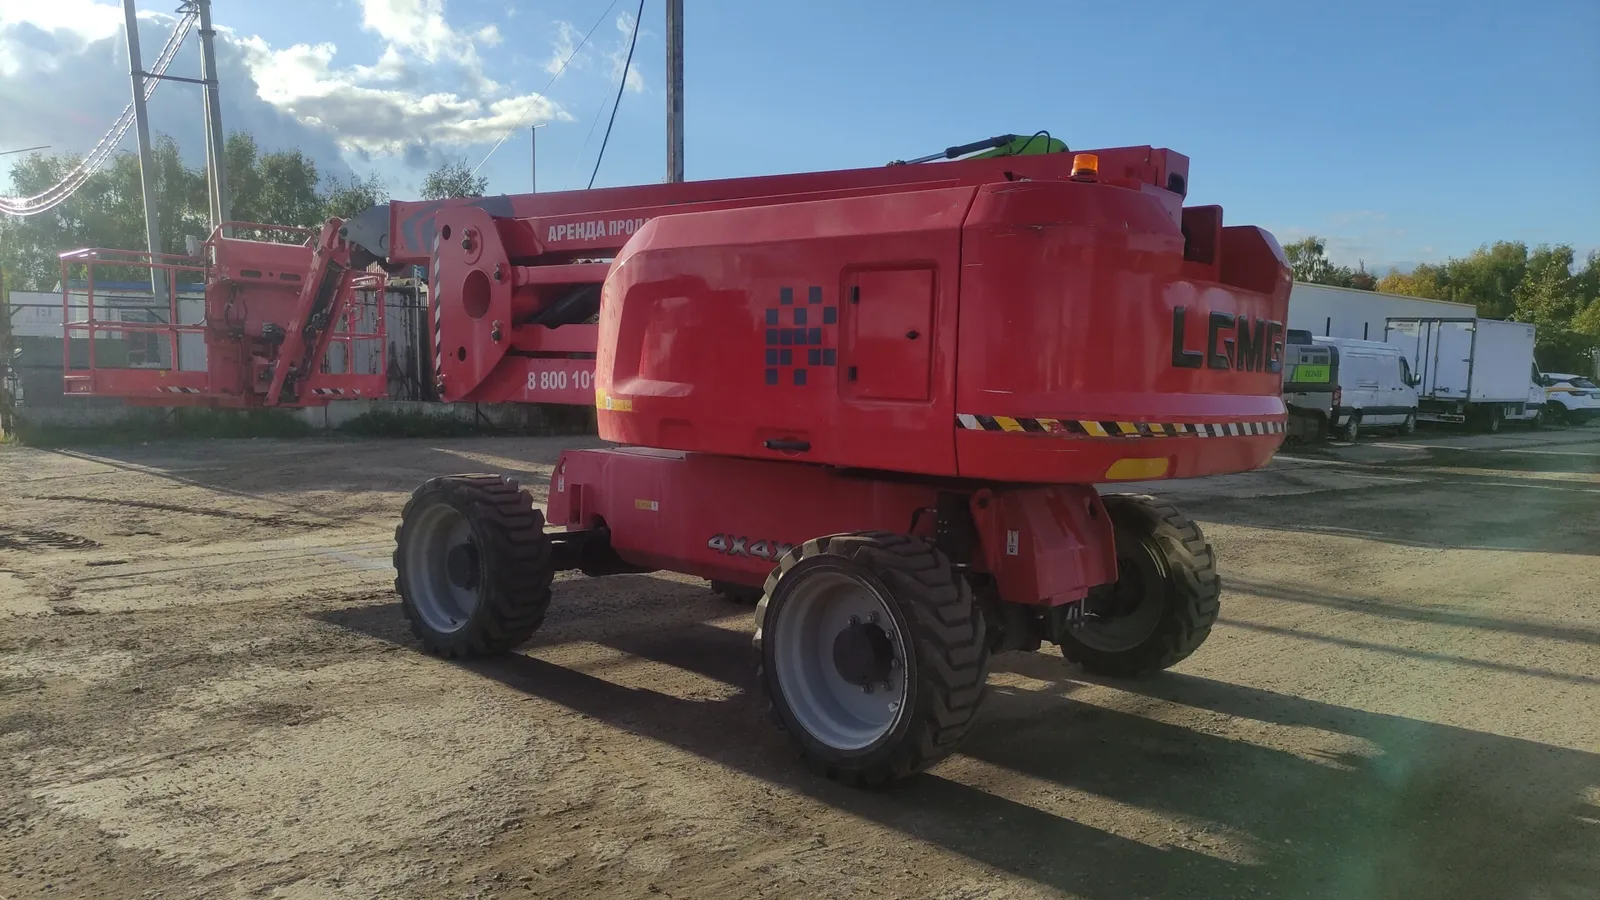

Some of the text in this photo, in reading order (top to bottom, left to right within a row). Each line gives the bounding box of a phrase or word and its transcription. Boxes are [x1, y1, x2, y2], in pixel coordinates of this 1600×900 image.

[548, 218, 651, 242] АРЕНДА ПРОД
[1172, 306, 1282, 373] LGMG
[527, 371, 536, 390] 8
[540, 371, 567, 390] 800
